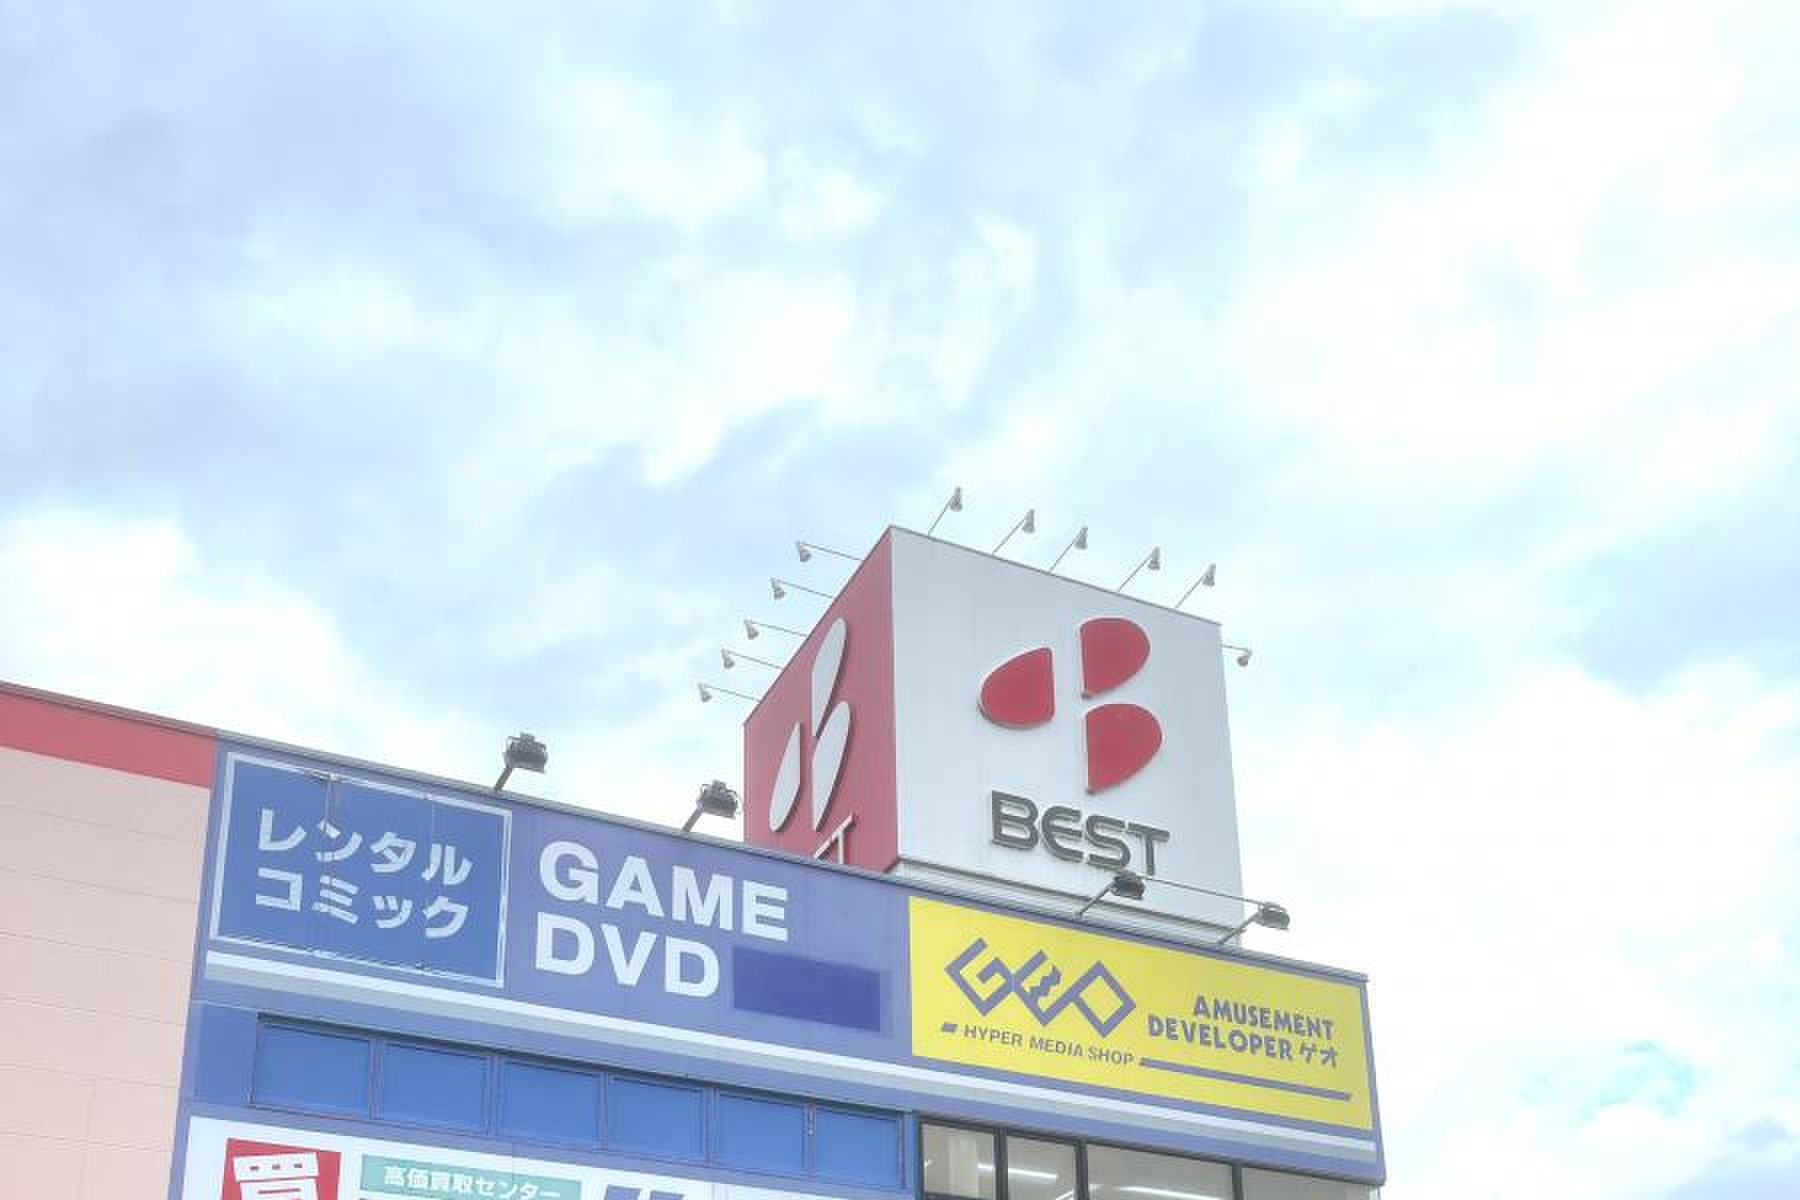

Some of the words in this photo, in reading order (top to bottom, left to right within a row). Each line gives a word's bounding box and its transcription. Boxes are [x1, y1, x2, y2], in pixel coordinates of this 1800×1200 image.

[257, 808, 474, 887] レンタル
[991, 790, 1170, 877] BEST
[255, 866, 468, 939] コミック
[538, 839, 789, 942] GAME
[535, 911, 721, 998] DVD
[963, 1024, 1024, 1048] HYPER
[1029, 1036, 1085, 1059] MEDIA
[1087, 1045, 1135, 1067] SHOP
[1147, 1013, 1294, 1062] DEVELOPER
[1299, 1041, 1340, 1068] ゲオ
[1193, 996, 1334, 1040] AMUSEMENT
